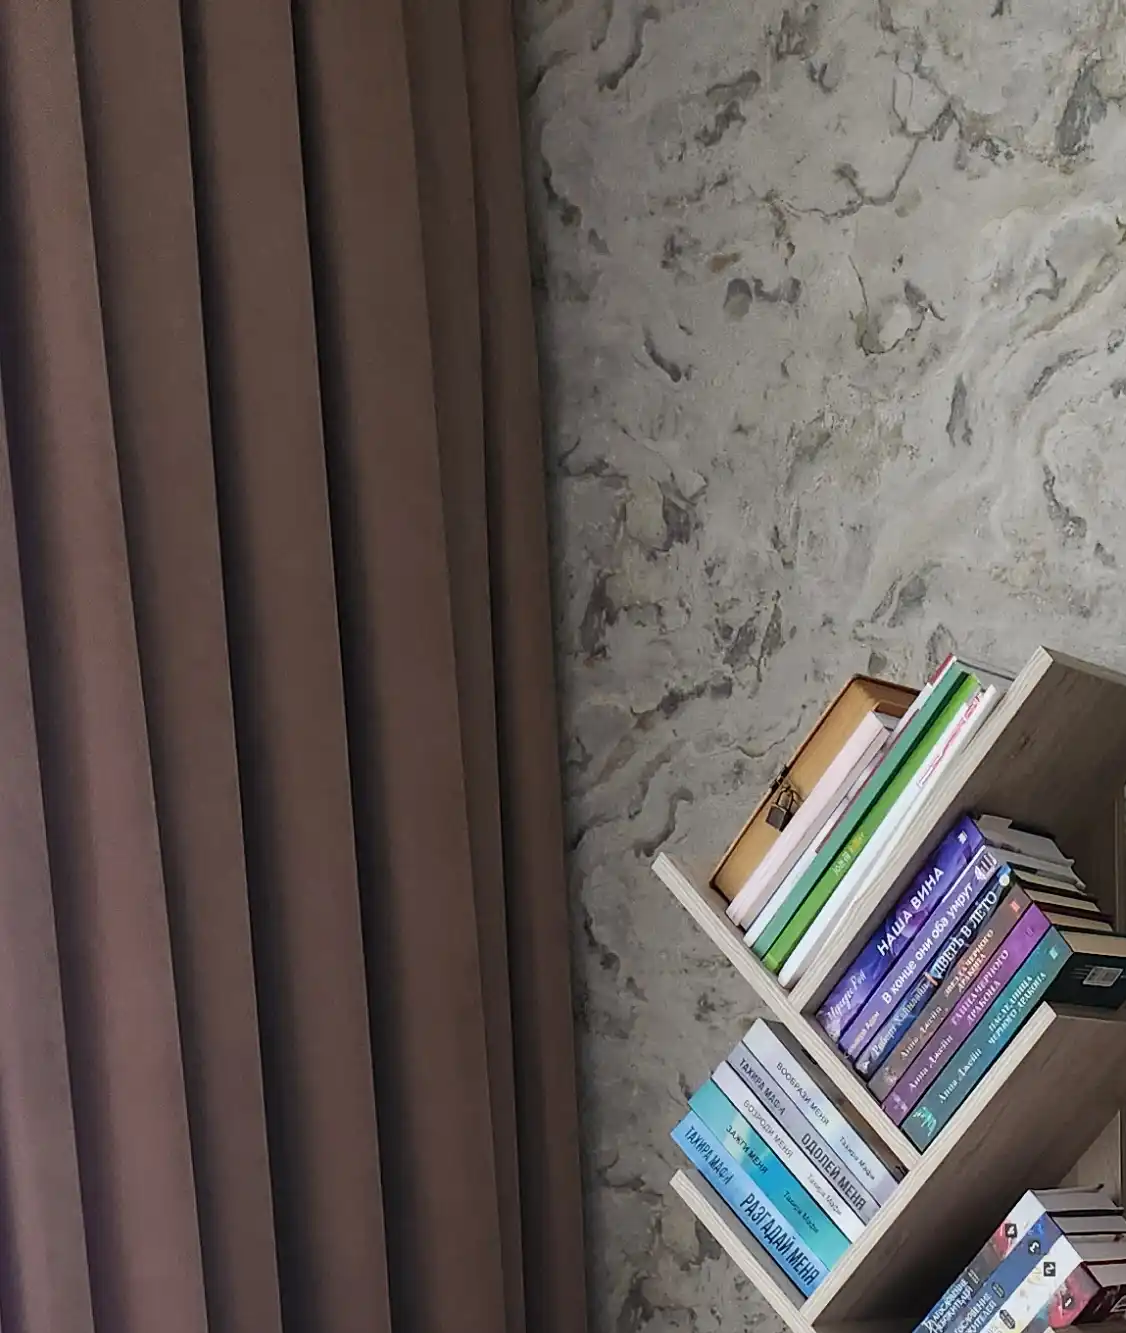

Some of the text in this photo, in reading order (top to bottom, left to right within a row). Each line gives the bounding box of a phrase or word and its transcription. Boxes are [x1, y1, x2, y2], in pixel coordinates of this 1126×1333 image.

[875, 865, 945, 956] НАША ВИНА
[880, 881, 977, 1004] В конце они оба умрут
[930, 889, 998, 978] ДВЕРЬ В ЛЕТО
[963, 978, 1002, 1026] ДРАКОНА
[986, 969, 1047, 1046] ЧЕРНОГО ДРАКОНА
[775, 1062, 830, 1126] ВООБРАЗИ МЕНЯ
[907, 1032, 955, 1091] Анна Джейн
[682, 1125, 715, 1161] ТАХИРА
[724, 1124, 768, 1174] ЗАЖГИ МЕНЯ
[742, 1098, 794, 1158] ВОЗРОДИ МЕНЯ
[797, 1131, 867, 1211] ОДОЛЕЙ МЕНЯ
[737, 1191, 821, 1286] РАЗГАДАЙ МЕНЯ
